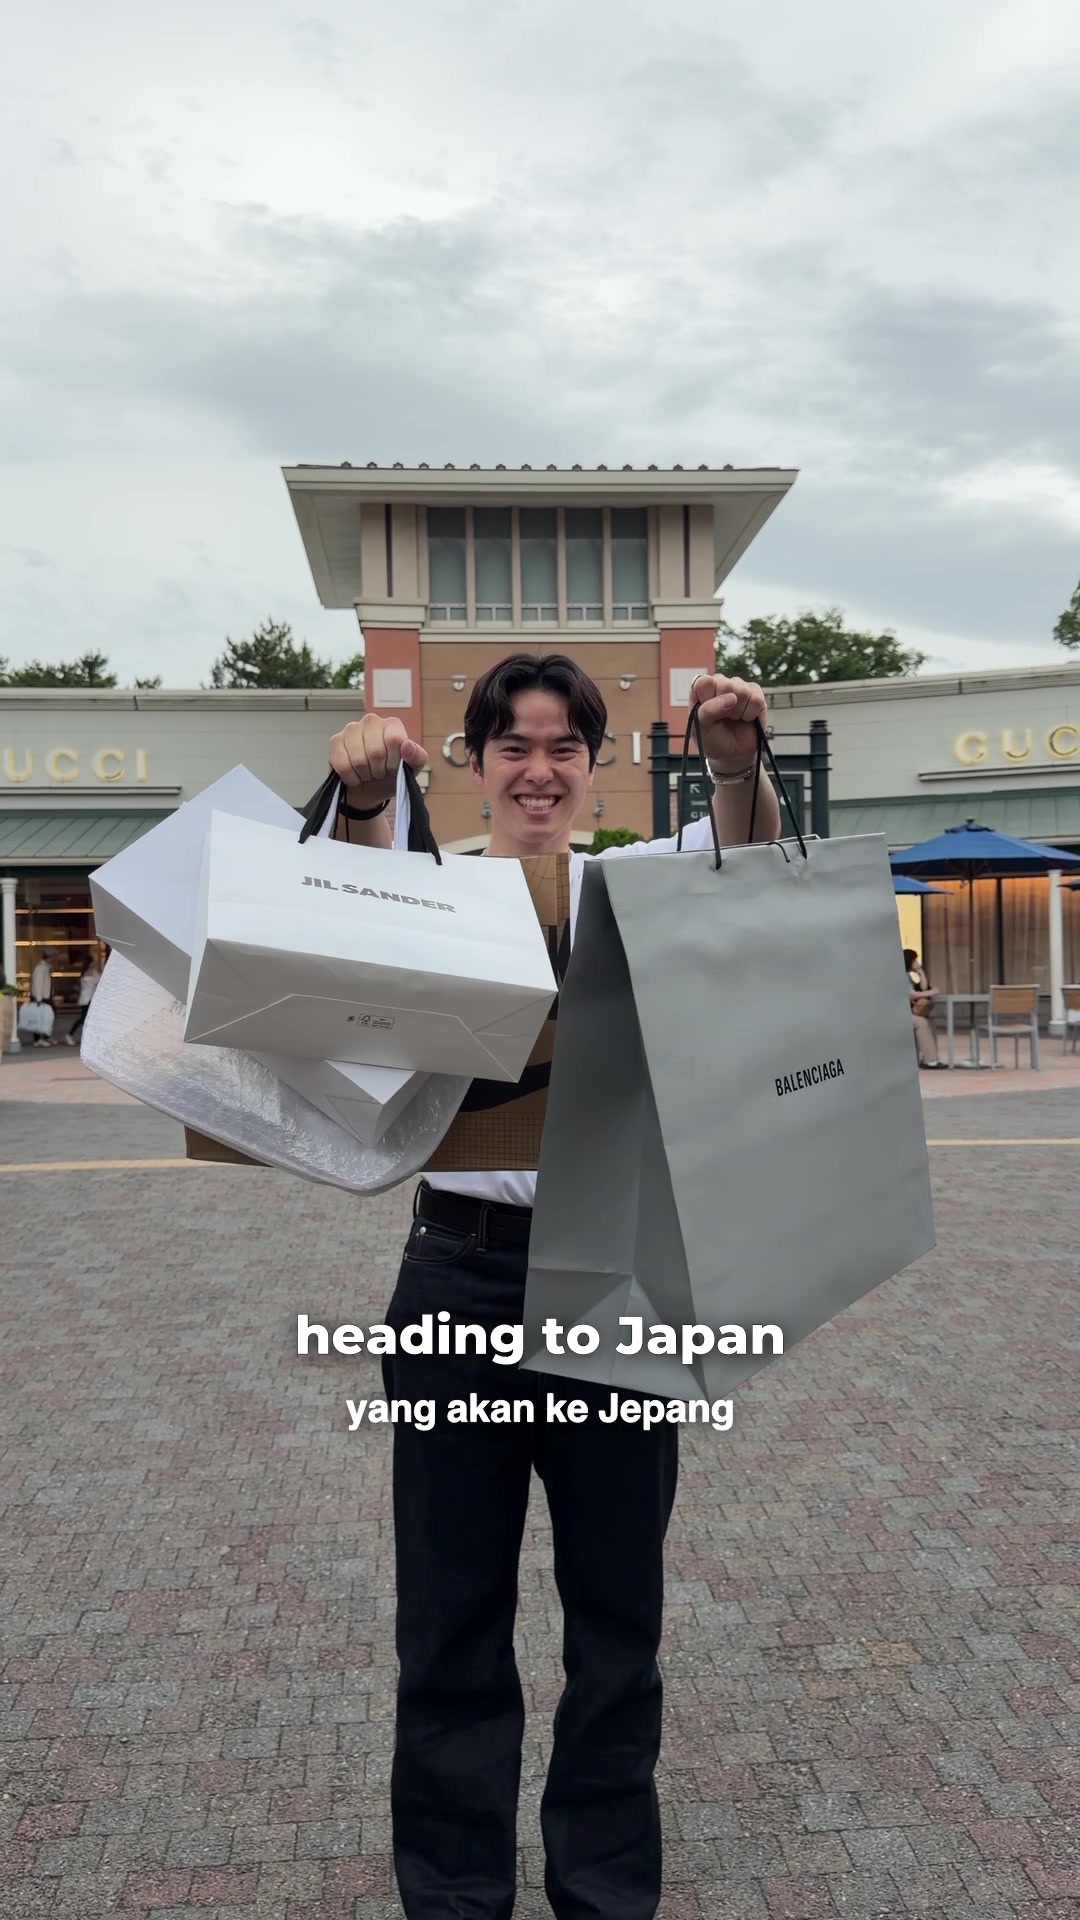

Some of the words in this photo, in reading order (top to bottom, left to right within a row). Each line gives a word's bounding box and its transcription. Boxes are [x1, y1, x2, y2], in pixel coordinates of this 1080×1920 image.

[301, 876, 339, 892] JIL
[341, 884, 457, 914] SANDER
[775, 1058, 845, 1097] BALENCIAGA
